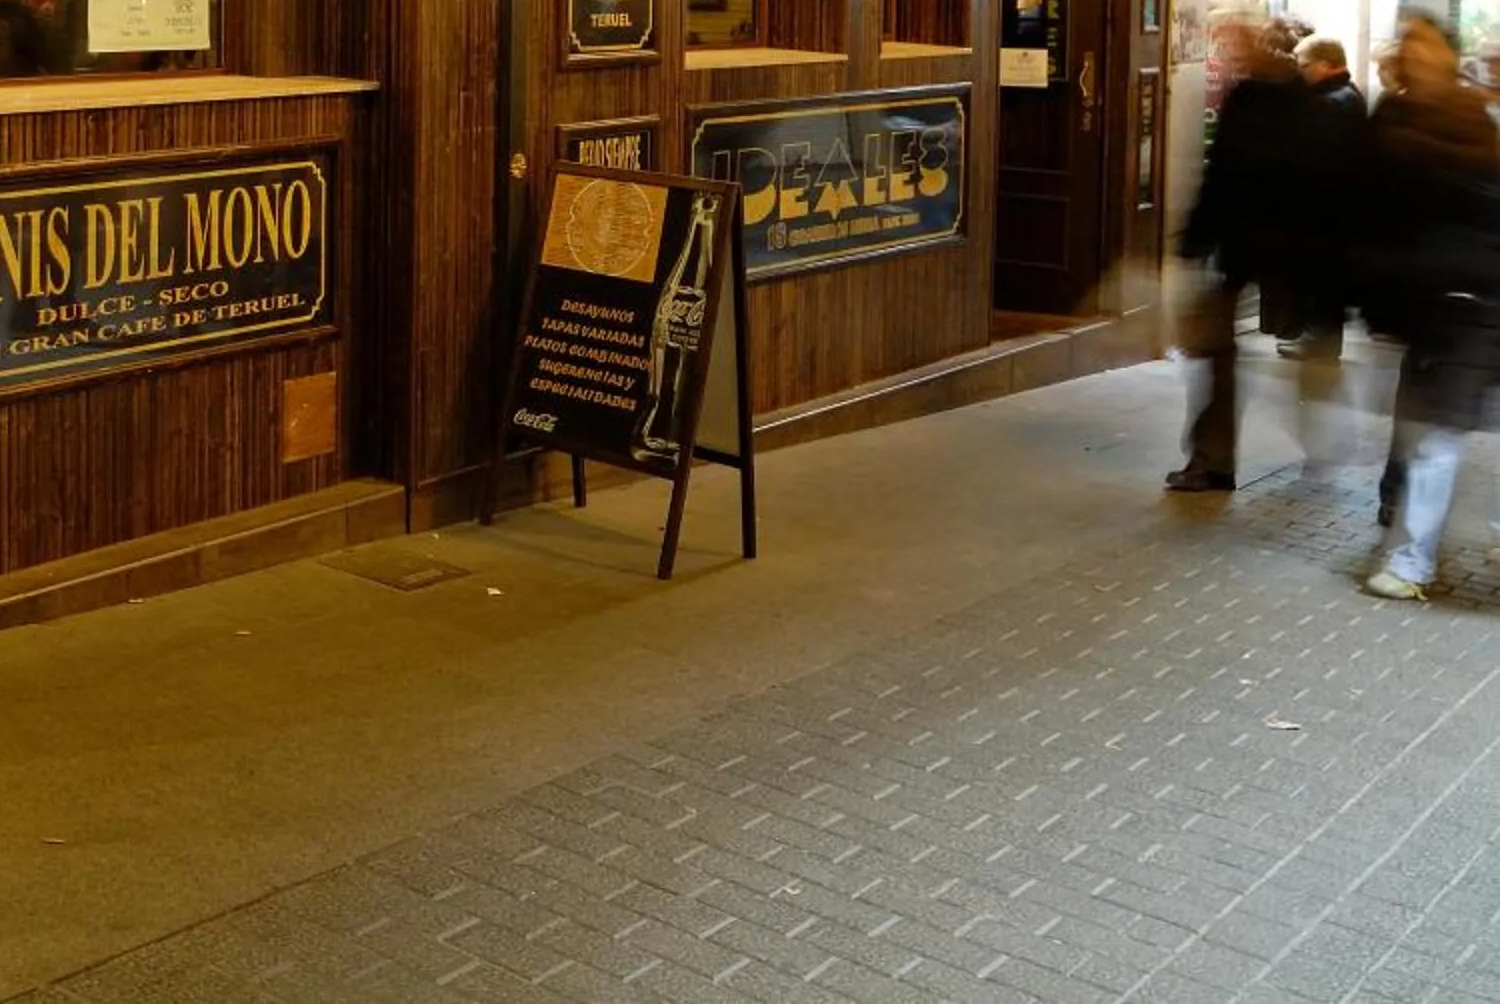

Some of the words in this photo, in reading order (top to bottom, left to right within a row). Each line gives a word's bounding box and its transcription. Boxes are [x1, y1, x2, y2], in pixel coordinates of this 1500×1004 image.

[591, 13, 632, 29] TERUEL
[83, 196, 176, 290] DEL
[183, 179, 313, 276] MONO
[9, 329, 90, 356] GRAN
[99, 317, 167, 342] CAFE
[173, 307, 207, 328] DE
[213, 292, 306, 321] TERUEL
[36, 295, 136, 328] DULCE
[158, 280, 230, 308] SECO
[524, 334, 568, 354] PLATOS
